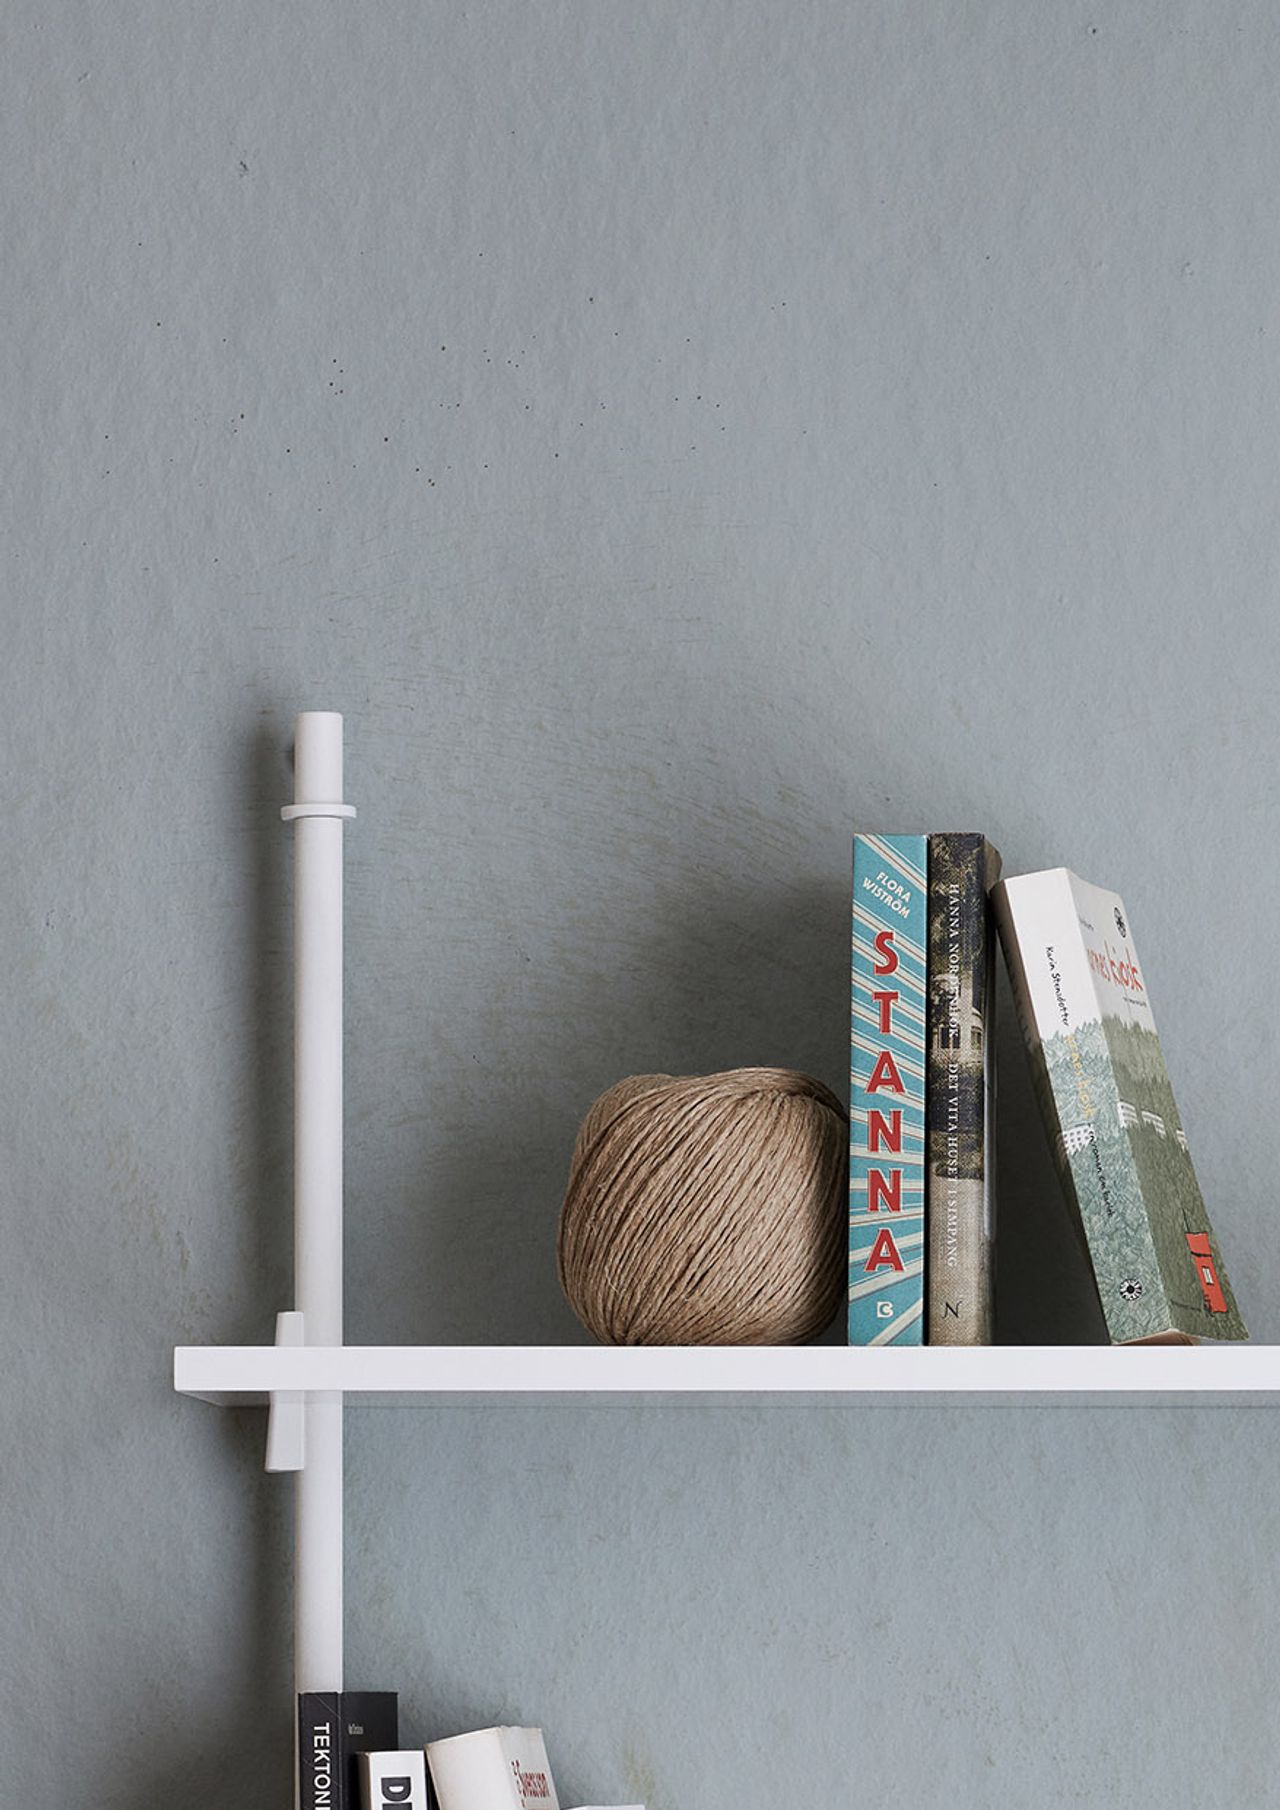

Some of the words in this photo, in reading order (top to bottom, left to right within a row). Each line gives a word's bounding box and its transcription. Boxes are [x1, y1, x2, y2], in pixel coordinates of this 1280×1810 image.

[862, 877, 910, 919] WISTRÖM
[875, 871, 912, 904] FLORA
[949, 884, 960, 938] HANNA
[1046, 946, 1054, 970] Karin
[948, 1063, 959, 1090] DET
[864, 931, 908, 1273] STANNA
[948, 1096, 959, 1132] VITA
[948, 1135, 960, 1181] HUSET
[947, 1200, 959, 1267] SIMPANG
